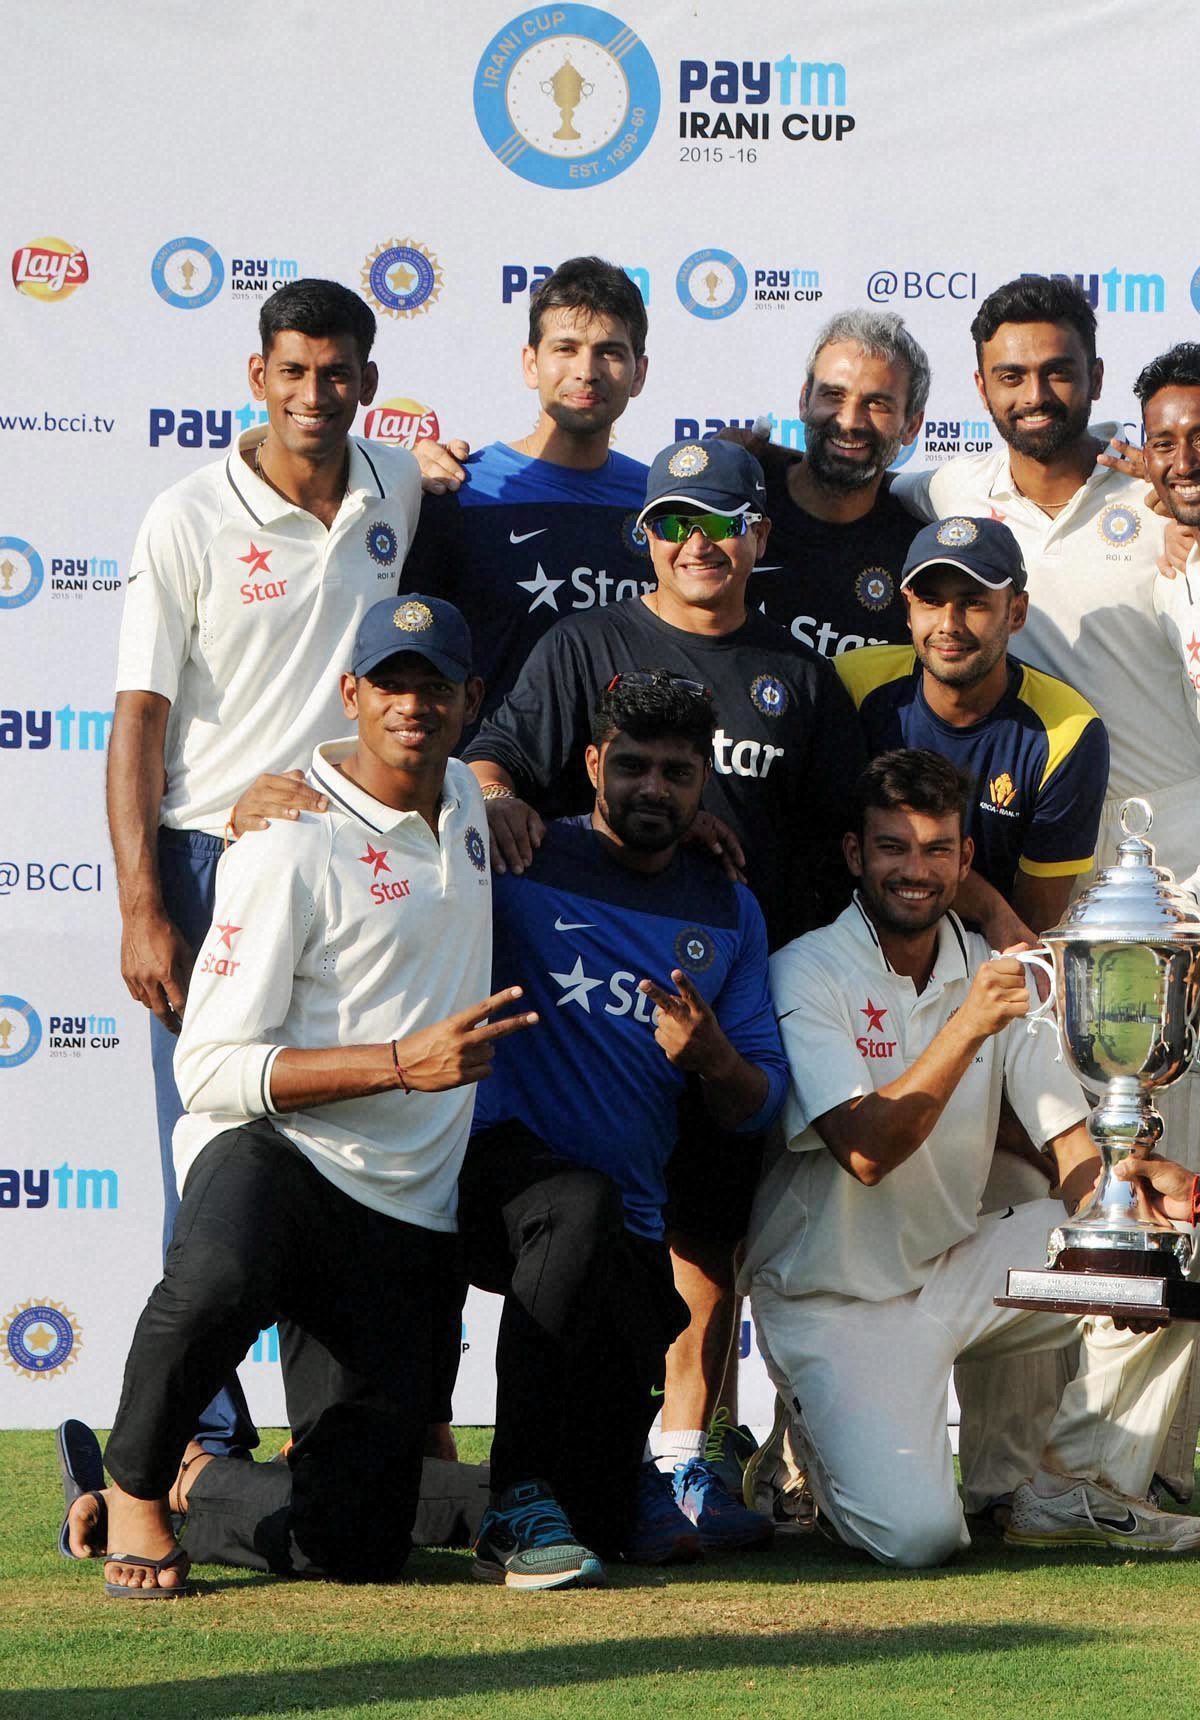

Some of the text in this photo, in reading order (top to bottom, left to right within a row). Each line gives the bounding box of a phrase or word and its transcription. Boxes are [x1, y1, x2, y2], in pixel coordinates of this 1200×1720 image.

[482, 11, 567, 89] IRANI CUP
[679, 112, 856, 142] IRANI CUP
[232, 280, 268, 291] IRANI
[755, 291, 823, 302] IRANI CUP
[867, 271, 977, 303] @BCCI
[925, 441, 993, 452] IRANI CUP
[51, 580, 88, 591] IRANI
[92, 580, 122, 592] CUP
[240, 579, 288, 604] Star
[711, 729, 784, 778] tar
[370, 876, 411, 906] Star
[200, 953, 241, 977] Star
[49, 1036, 120, 1048] IRANI CUP
[856, 1037, 897, 1058] Star
